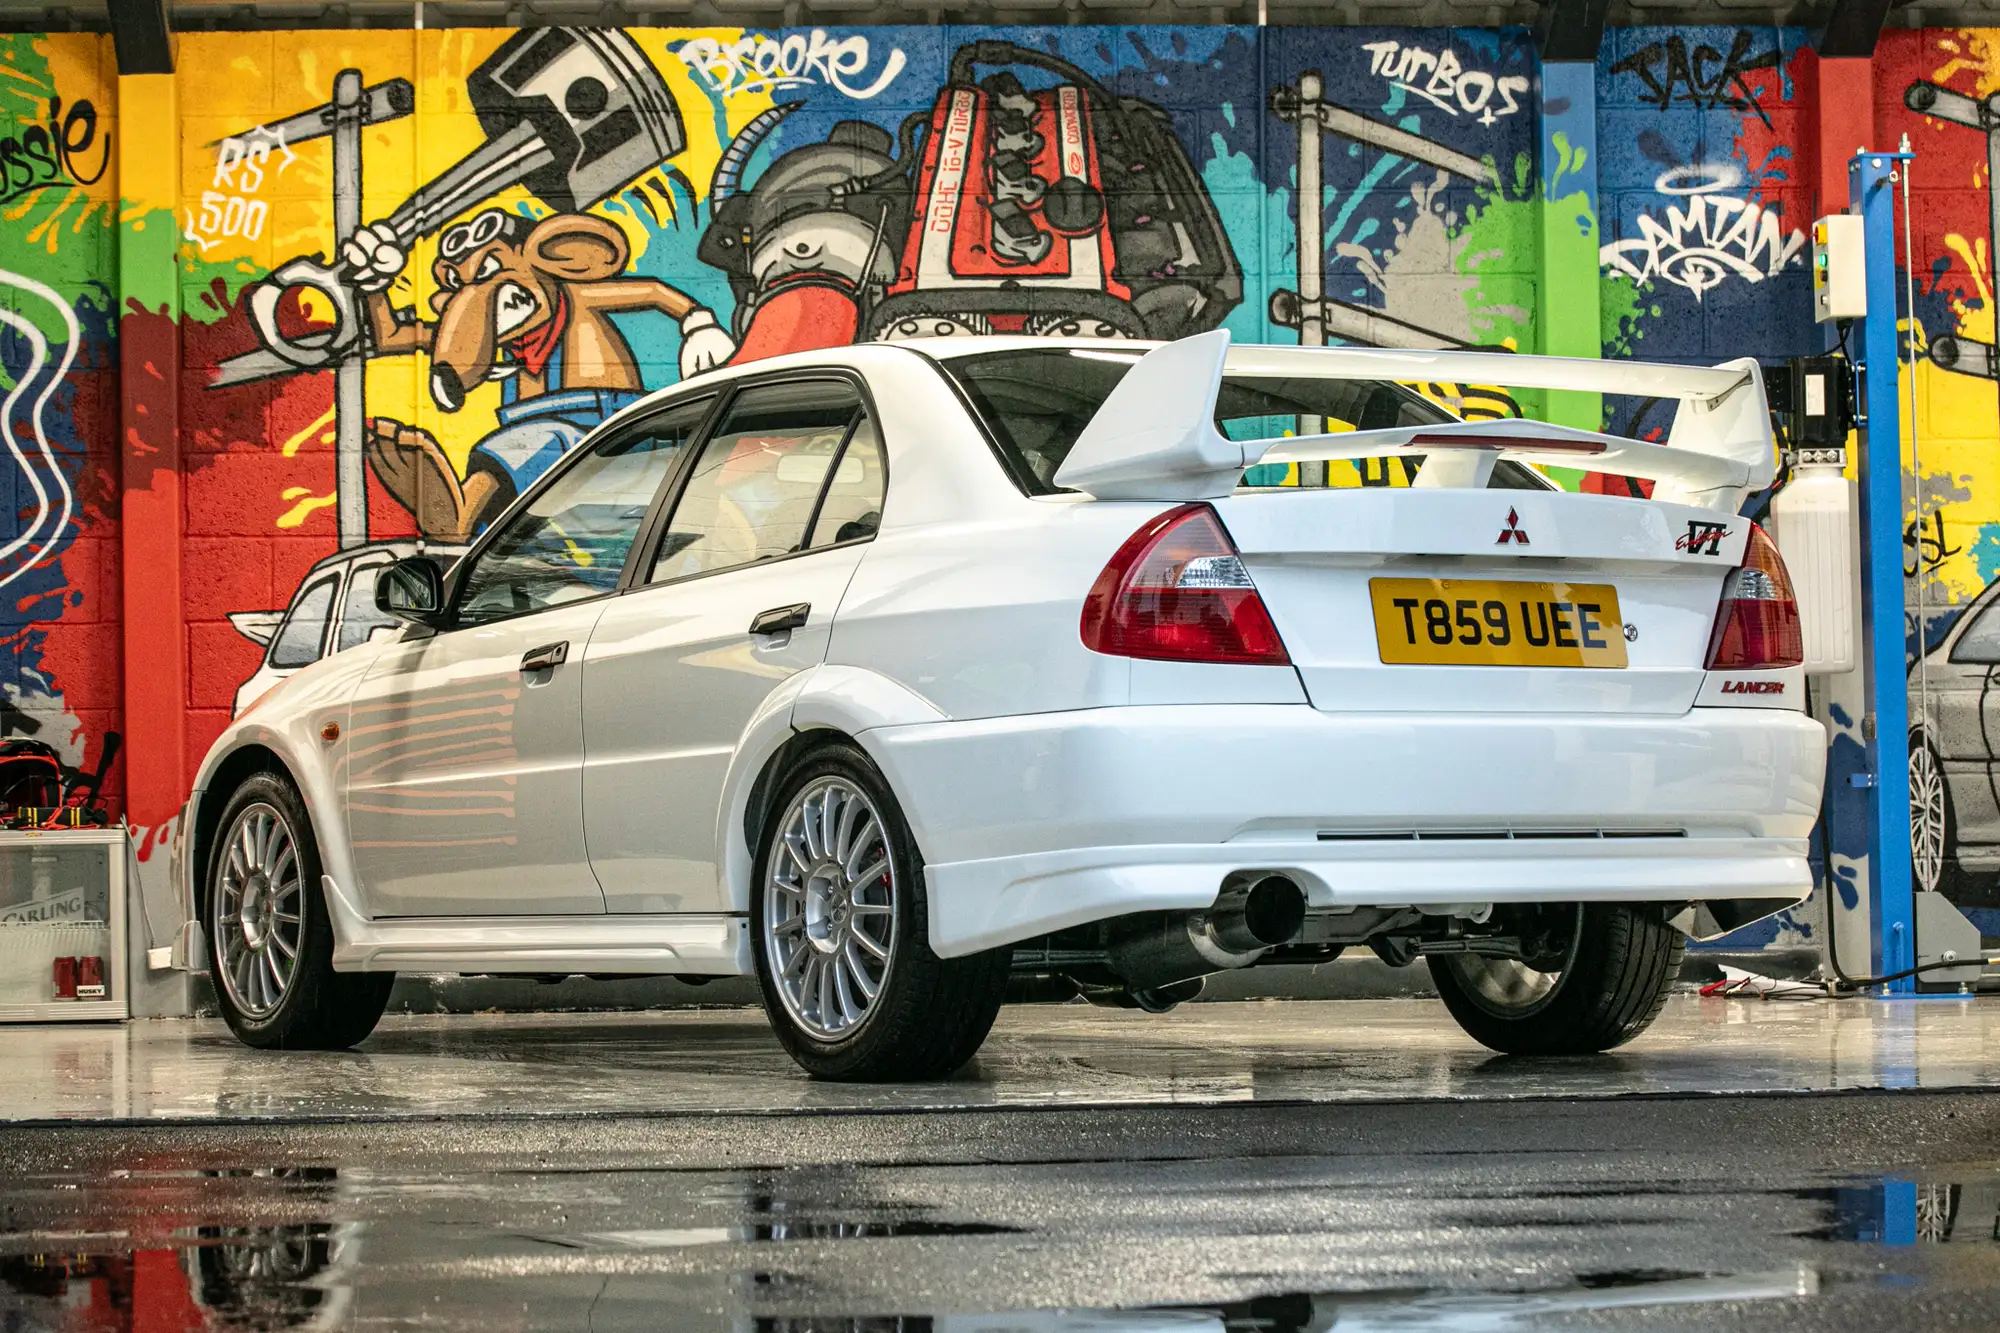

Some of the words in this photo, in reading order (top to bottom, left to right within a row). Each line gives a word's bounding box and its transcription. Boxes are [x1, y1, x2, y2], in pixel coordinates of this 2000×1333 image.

[1609, 30, 1786, 134] JACK
[1062, 90, 1080, 144] COSWORTH
[0, 95, 110, 196] ssie
[213, 137, 271, 193] RS
[930, 181, 957, 233] DOHC
[950, 91, 971, 133] TURBO
[199, 190, 267, 242] 500
[1599, 195, 1805, 288] DAMIAN
[1393, 598, 1511, 646] T859
[1520, 601, 1607, 649] UEE
[1721, 680, 1785, 694] LANCER
[1, 897, 81, 927] CARLING
